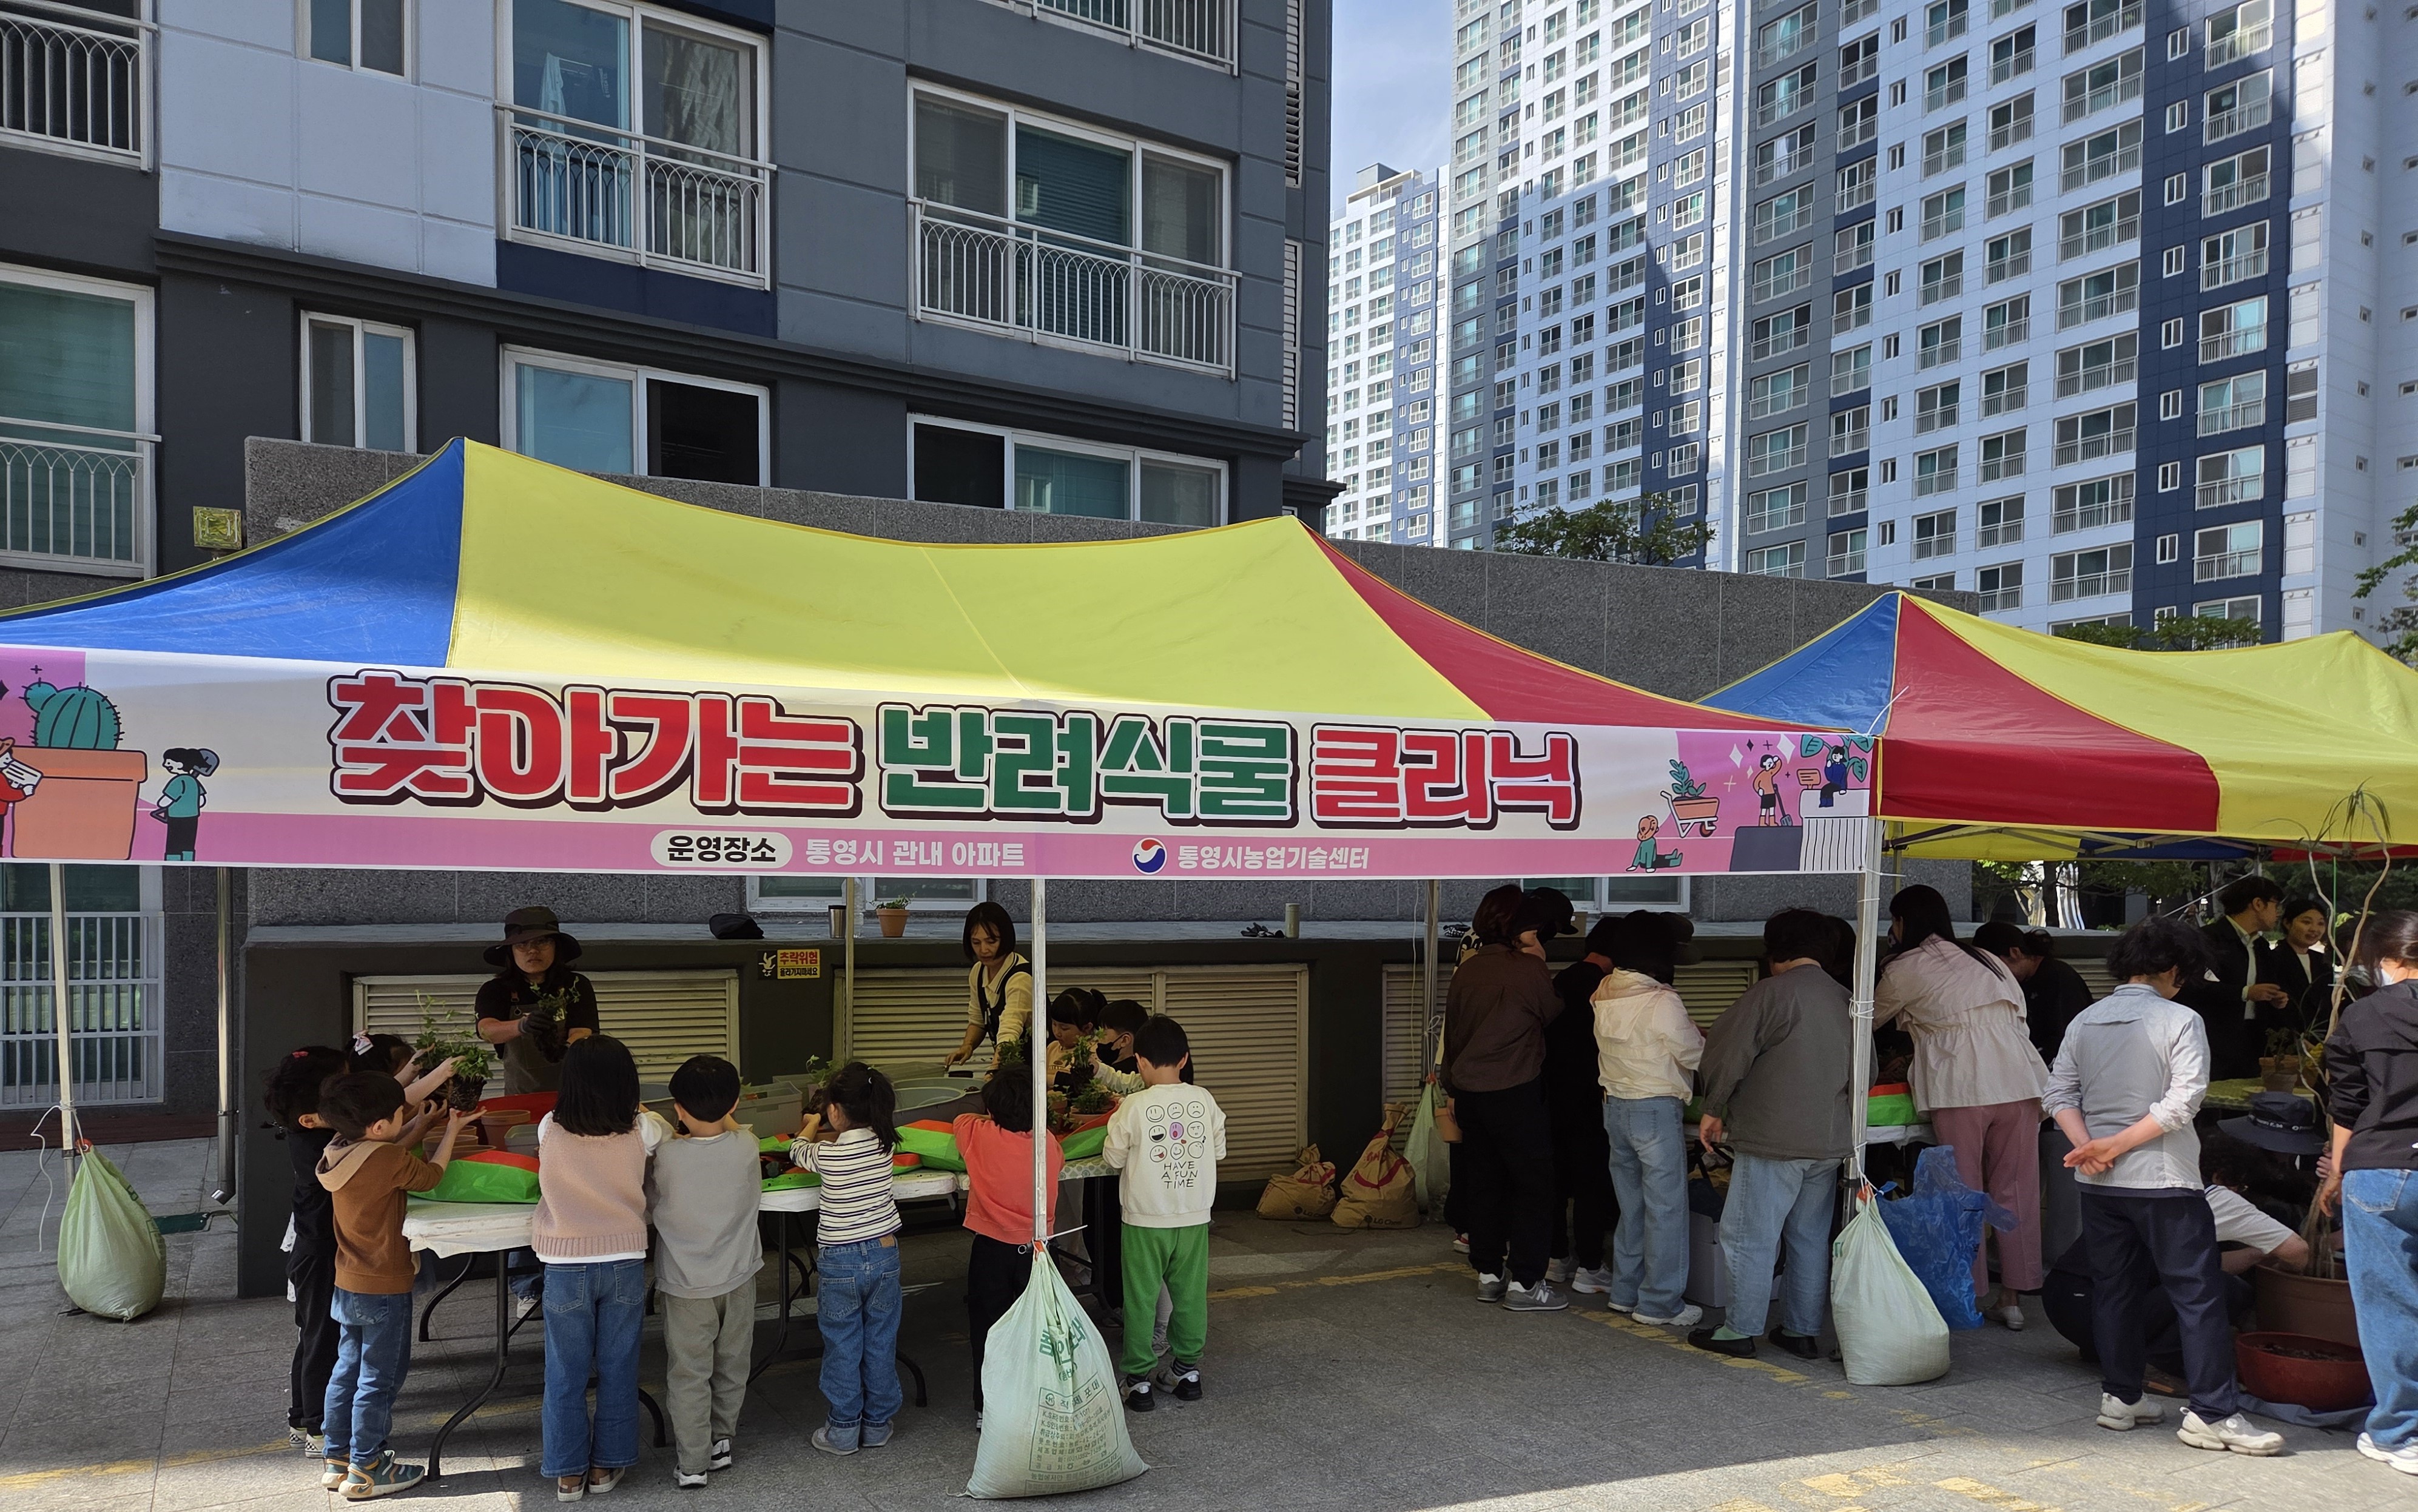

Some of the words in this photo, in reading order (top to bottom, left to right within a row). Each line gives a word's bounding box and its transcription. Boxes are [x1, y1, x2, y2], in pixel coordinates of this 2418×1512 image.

[329, 669, 863, 817] 찾아가는
[877, 702, 1298, 828] 반려식물
[1310, 723, 1581, 830] 클리닉
[667, 835, 776, 864] 운영장소
[806, 839, 884, 866] 통영시
[893, 840, 943, 867] 관내
[952, 841, 1025, 868] 아파트
[1177, 845, 1370, 870] 통영시농업기술센터
[780, 951, 818, 965] 추락위험
[1164, 1161, 1194, 1171] HAVE
[1175, 1170, 1198, 1180] FUN
[1164, 1178, 1194, 1189] TIME
